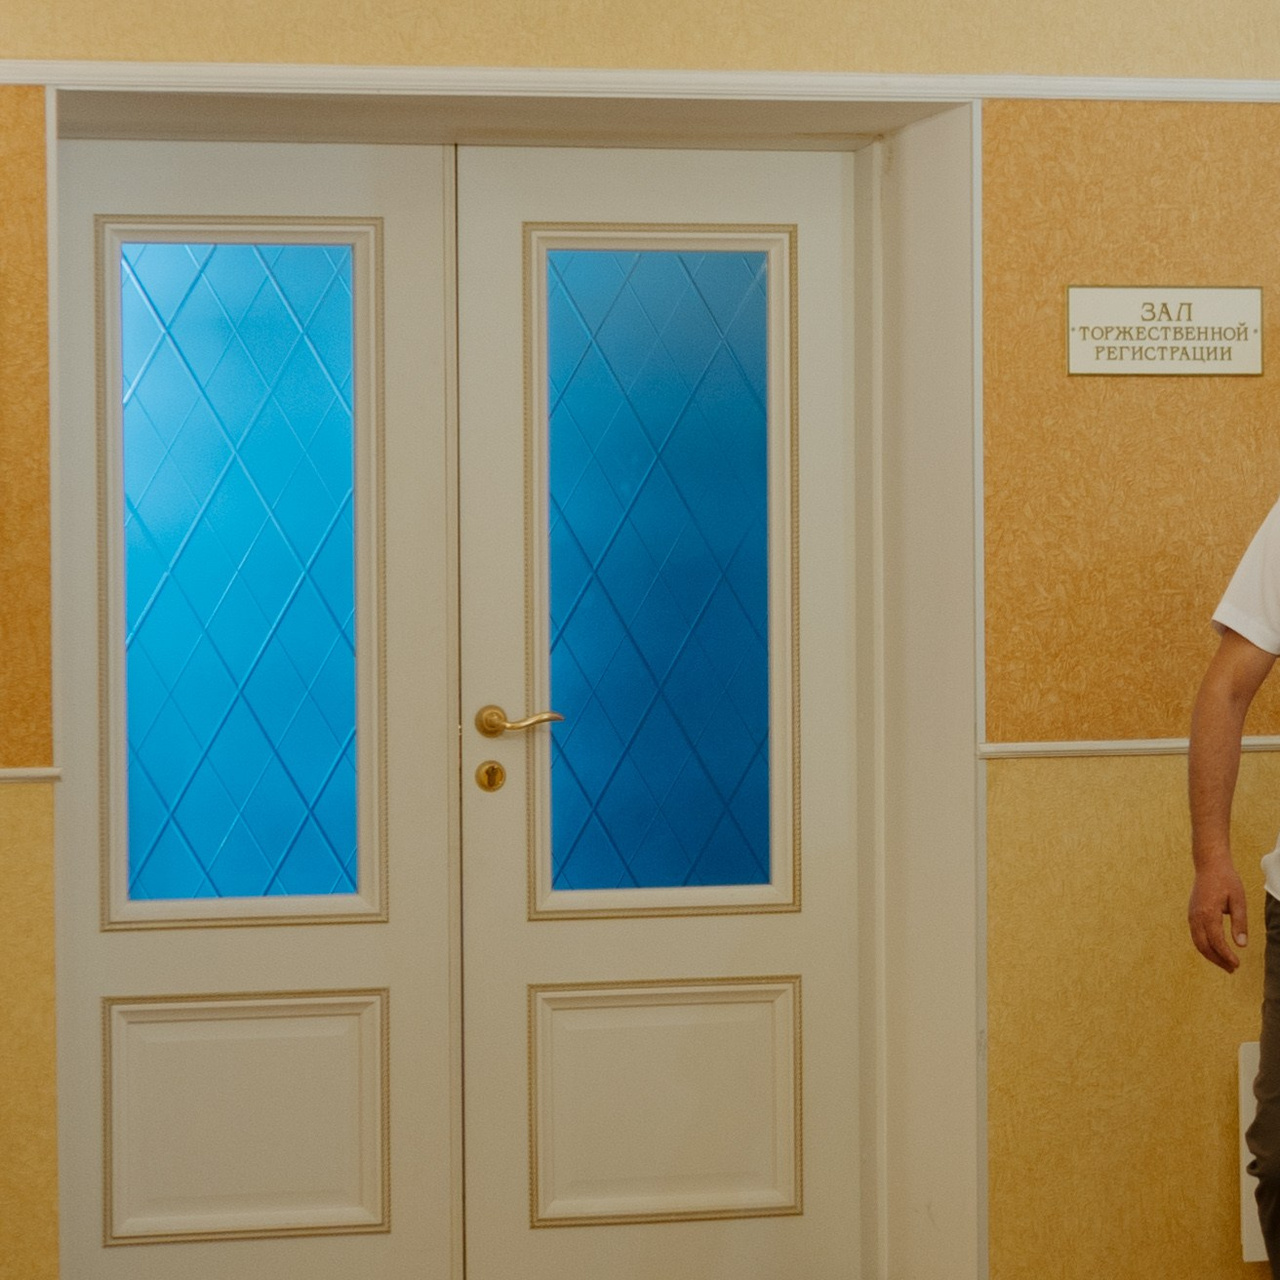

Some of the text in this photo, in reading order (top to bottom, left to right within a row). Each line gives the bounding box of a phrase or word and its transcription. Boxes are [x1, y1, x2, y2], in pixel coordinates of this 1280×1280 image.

[1140, 302, 1193, 322] ЗАЛ
[1079, 322, 1248, 342] ТОРЖЕСТВЕННОЙ
[1095, 345, 1232, 363] РЕГИСТРАЦИИ
